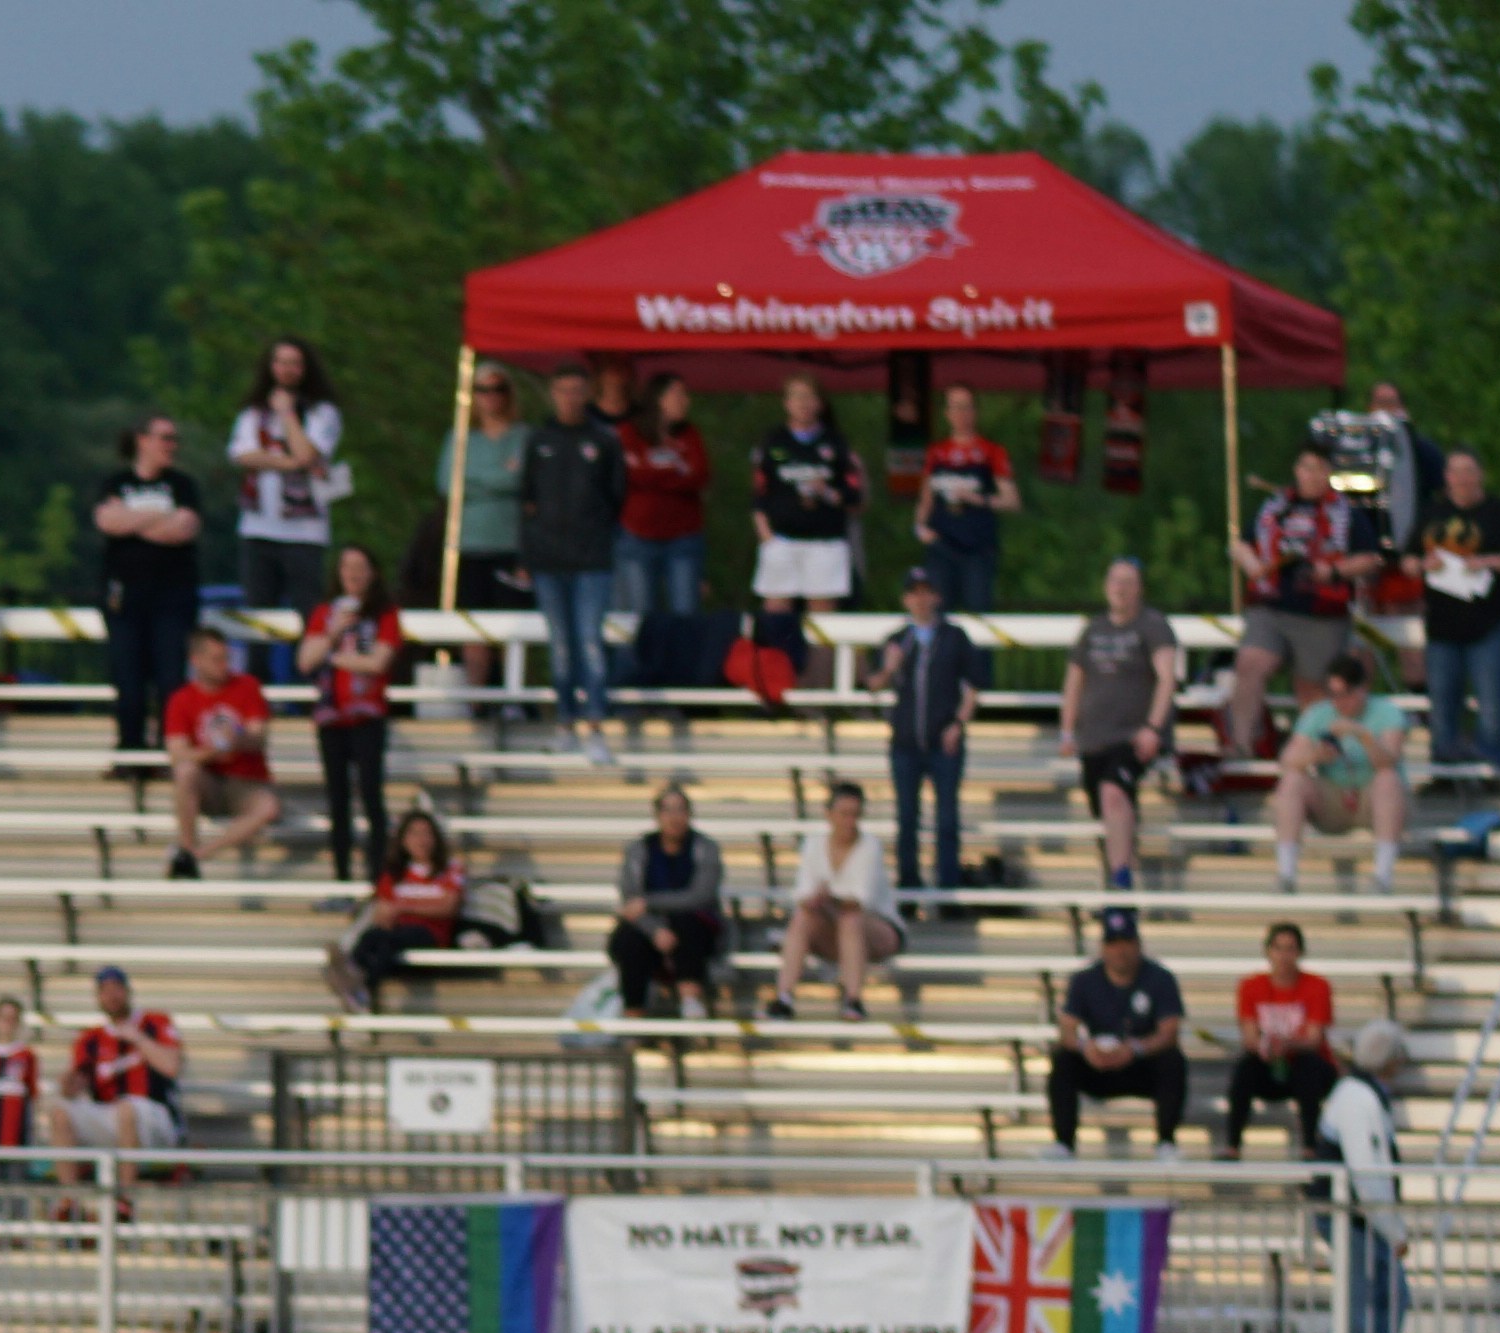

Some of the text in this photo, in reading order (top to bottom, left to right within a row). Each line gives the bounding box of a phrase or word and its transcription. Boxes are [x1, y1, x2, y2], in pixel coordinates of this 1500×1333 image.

[636, 296, 1053, 338] Washington Spirit
[628, 1223, 675, 1248] NO
[681, 1223, 770, 1248] HATE.
[778, 1223, 825, 1248] NO
